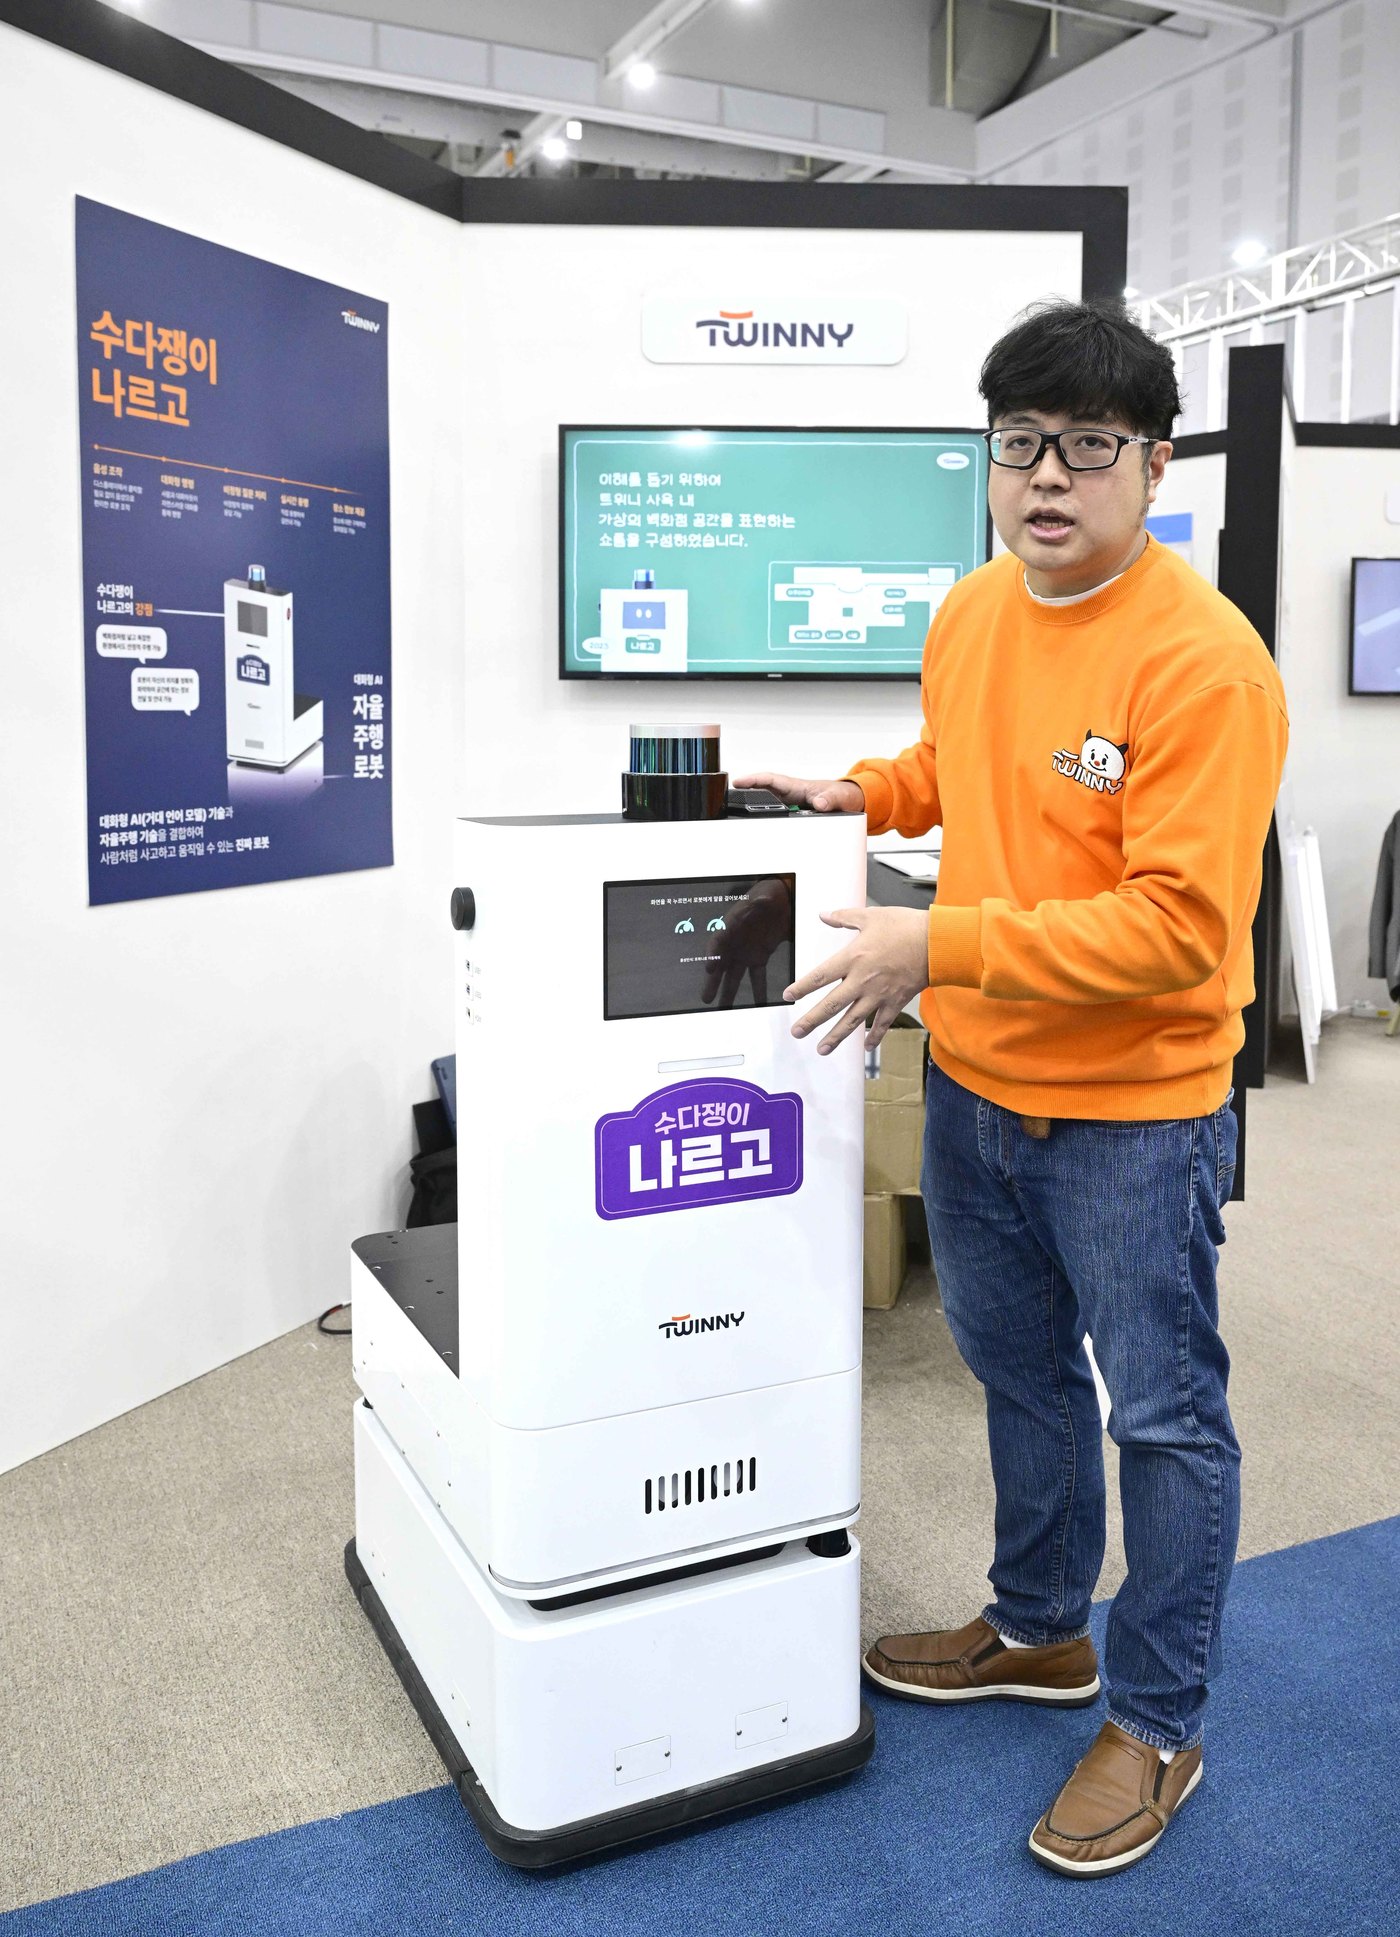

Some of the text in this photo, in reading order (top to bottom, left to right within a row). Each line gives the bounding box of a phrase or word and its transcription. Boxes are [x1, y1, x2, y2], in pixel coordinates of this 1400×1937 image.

[341, 309, 380, 333] TWINNY
[696, 310, 854, 348] TWINNY
[90, 310, 217, 385] 수다쟁이
[92, 367, 190, 427] 나르고
[599, 472, 721, 488] 이해를 돕기 위하여
[599, 492, 641, 506] 트위니
[678, 493, 695, 507] 내
[598, 512, 796, 528] 가상의 백화점 공간을 표현하는
[599, 532, 748, 548] 쇼룸을 구성하였습니다.
[96, 583, 134, 599] 수다쟁이
[96, 599, 153, 617] 나르고의 강점
[241, 664, 267, 681] 나르고
[353, 673, 383, 686] 대화형 AI
[353, 694, 384, 720] 자율
[353, 723, 384, 750] 주행
[353, 754, 384, 779] 로봇
[1052, 748, 1123, 795] TWINNY
[99, 806, 234, 829] 대화형 AI(거대 언어 모델) 기술과
[99, 825, 204, 847] 자율주행 기술을 결합하여
[100, 836, 270, 865] 사람처럼 사고하고 움직일 수 있는 진짜 로봇
[672, 897, 692, 905] 누르면서
[654, 1102, 750, 1135] 수다쟁이
[629, 1128, 773, 1193] 나르고
[658, 1311, 745, 1339] TWINNY
